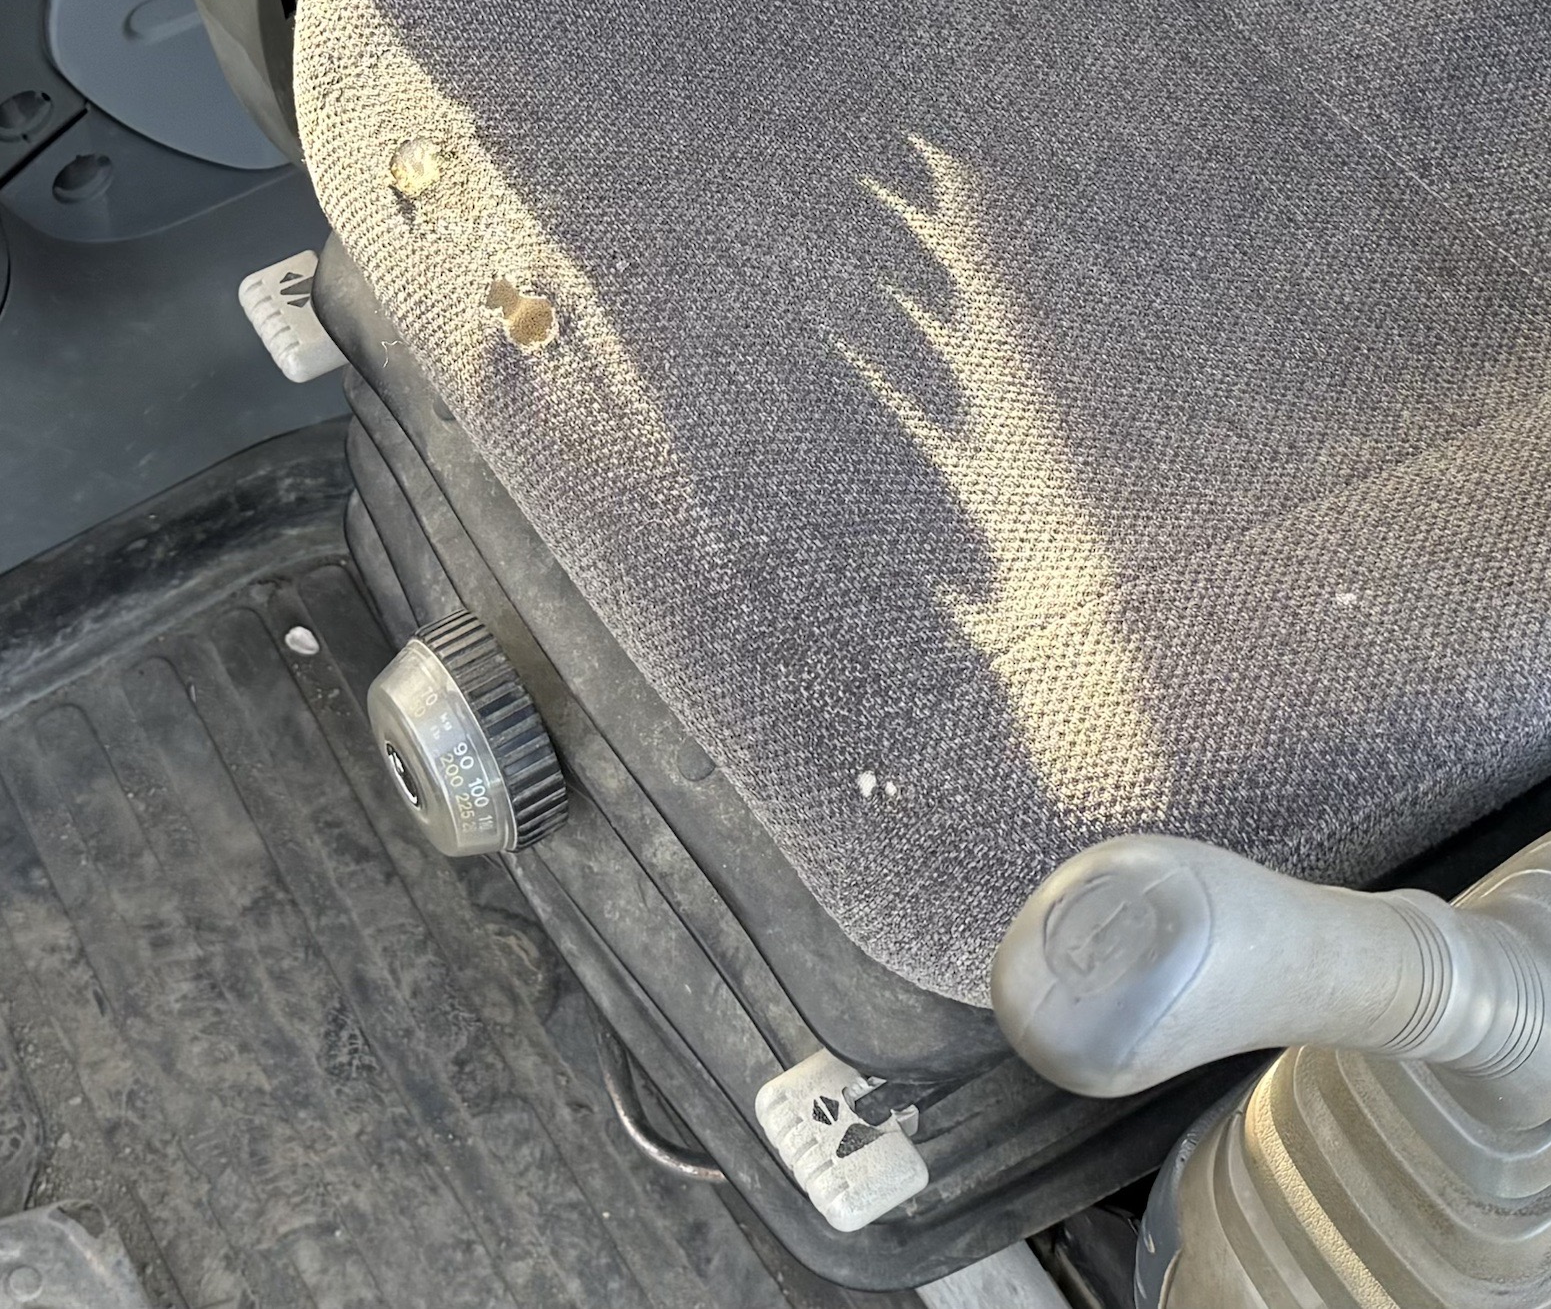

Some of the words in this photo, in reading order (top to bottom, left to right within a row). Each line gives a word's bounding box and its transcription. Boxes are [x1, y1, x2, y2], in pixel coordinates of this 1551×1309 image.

[440, 753, 464, 787] 200
[456, 793, 474, 819] 225
[454, 742, 474, 770] 90
[468, 778, 489, 808] 100
